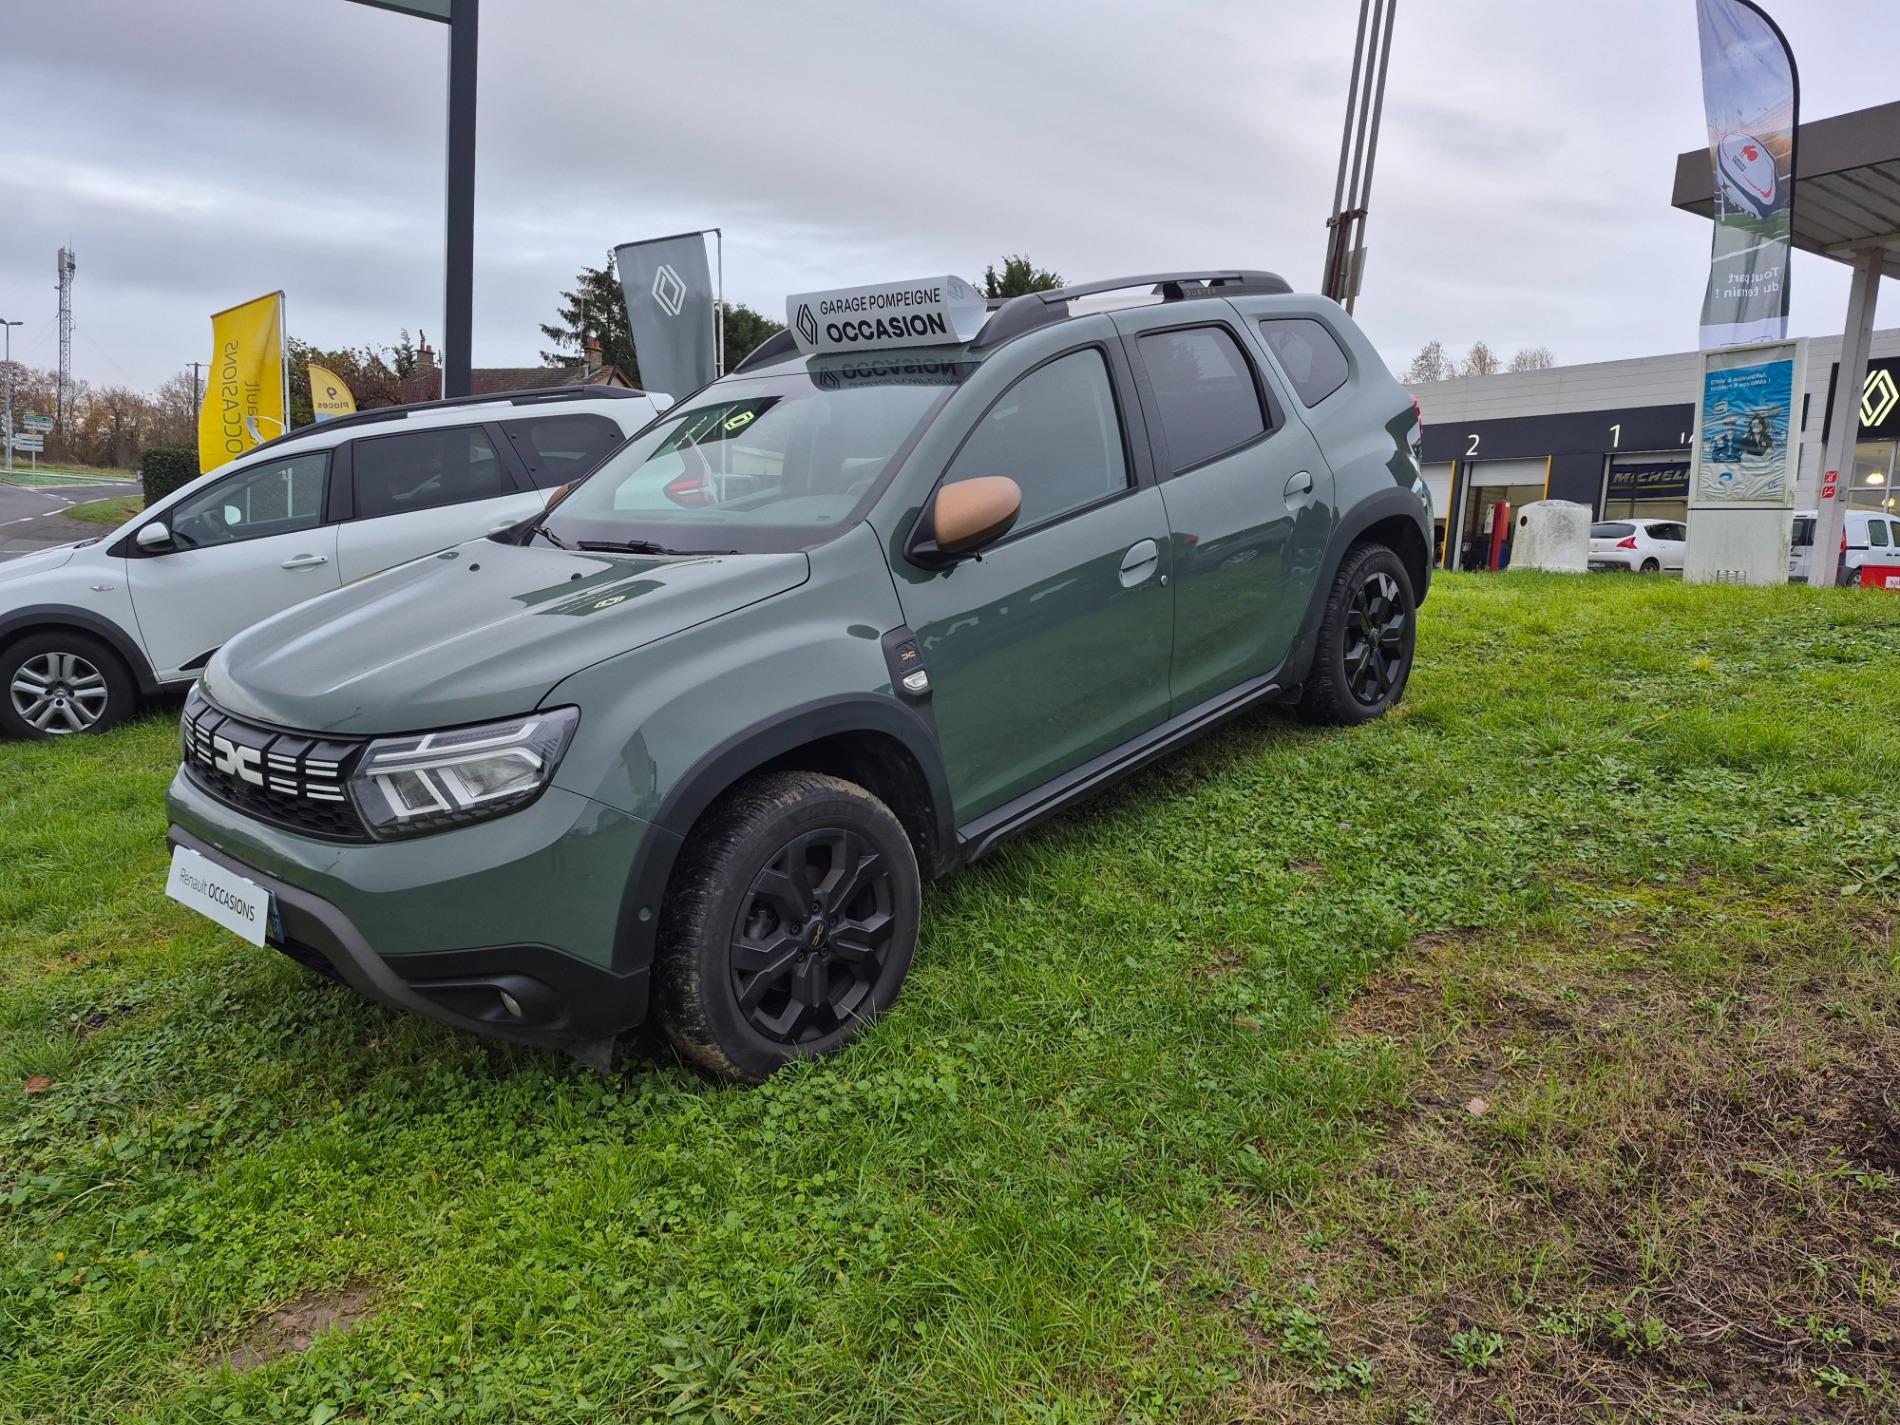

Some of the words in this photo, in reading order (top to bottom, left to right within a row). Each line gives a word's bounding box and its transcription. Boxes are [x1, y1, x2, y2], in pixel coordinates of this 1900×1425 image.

[820, 297, 866, 315] GARAGE
[869, 287, 941, 310] POMPEIGNE
[826, 312, 947, 343] OCCASION
[1465, 434, 1480, 456] 2
[1609, 424, 1621, 448] 1
[1613, 468, 1691, 483] MICHELI
[179, 867, 208, 896] Renault
[208, 883, 255, 922] OCCASIONS
